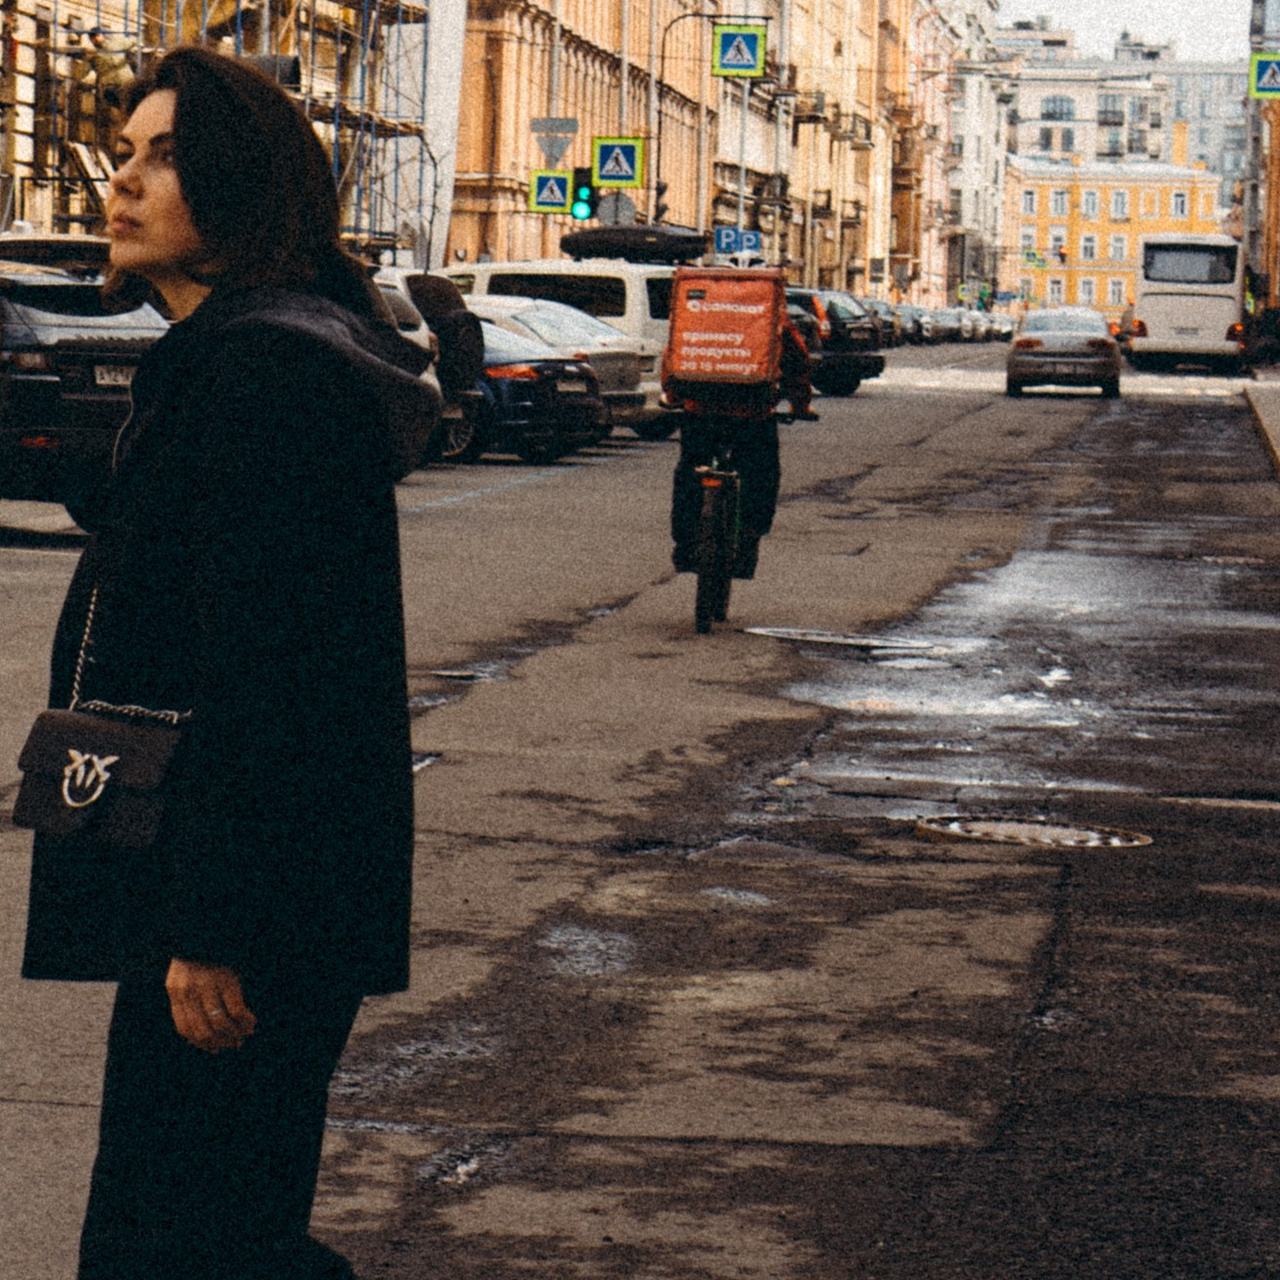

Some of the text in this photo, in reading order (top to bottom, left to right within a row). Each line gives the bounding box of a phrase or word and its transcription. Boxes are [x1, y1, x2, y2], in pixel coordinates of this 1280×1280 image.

[720, 229, 735, 249] P
[682, 331, 744, 346] принесу
[681, 345, 751, 359] продукты
[715, 362, 759, 376] минут
